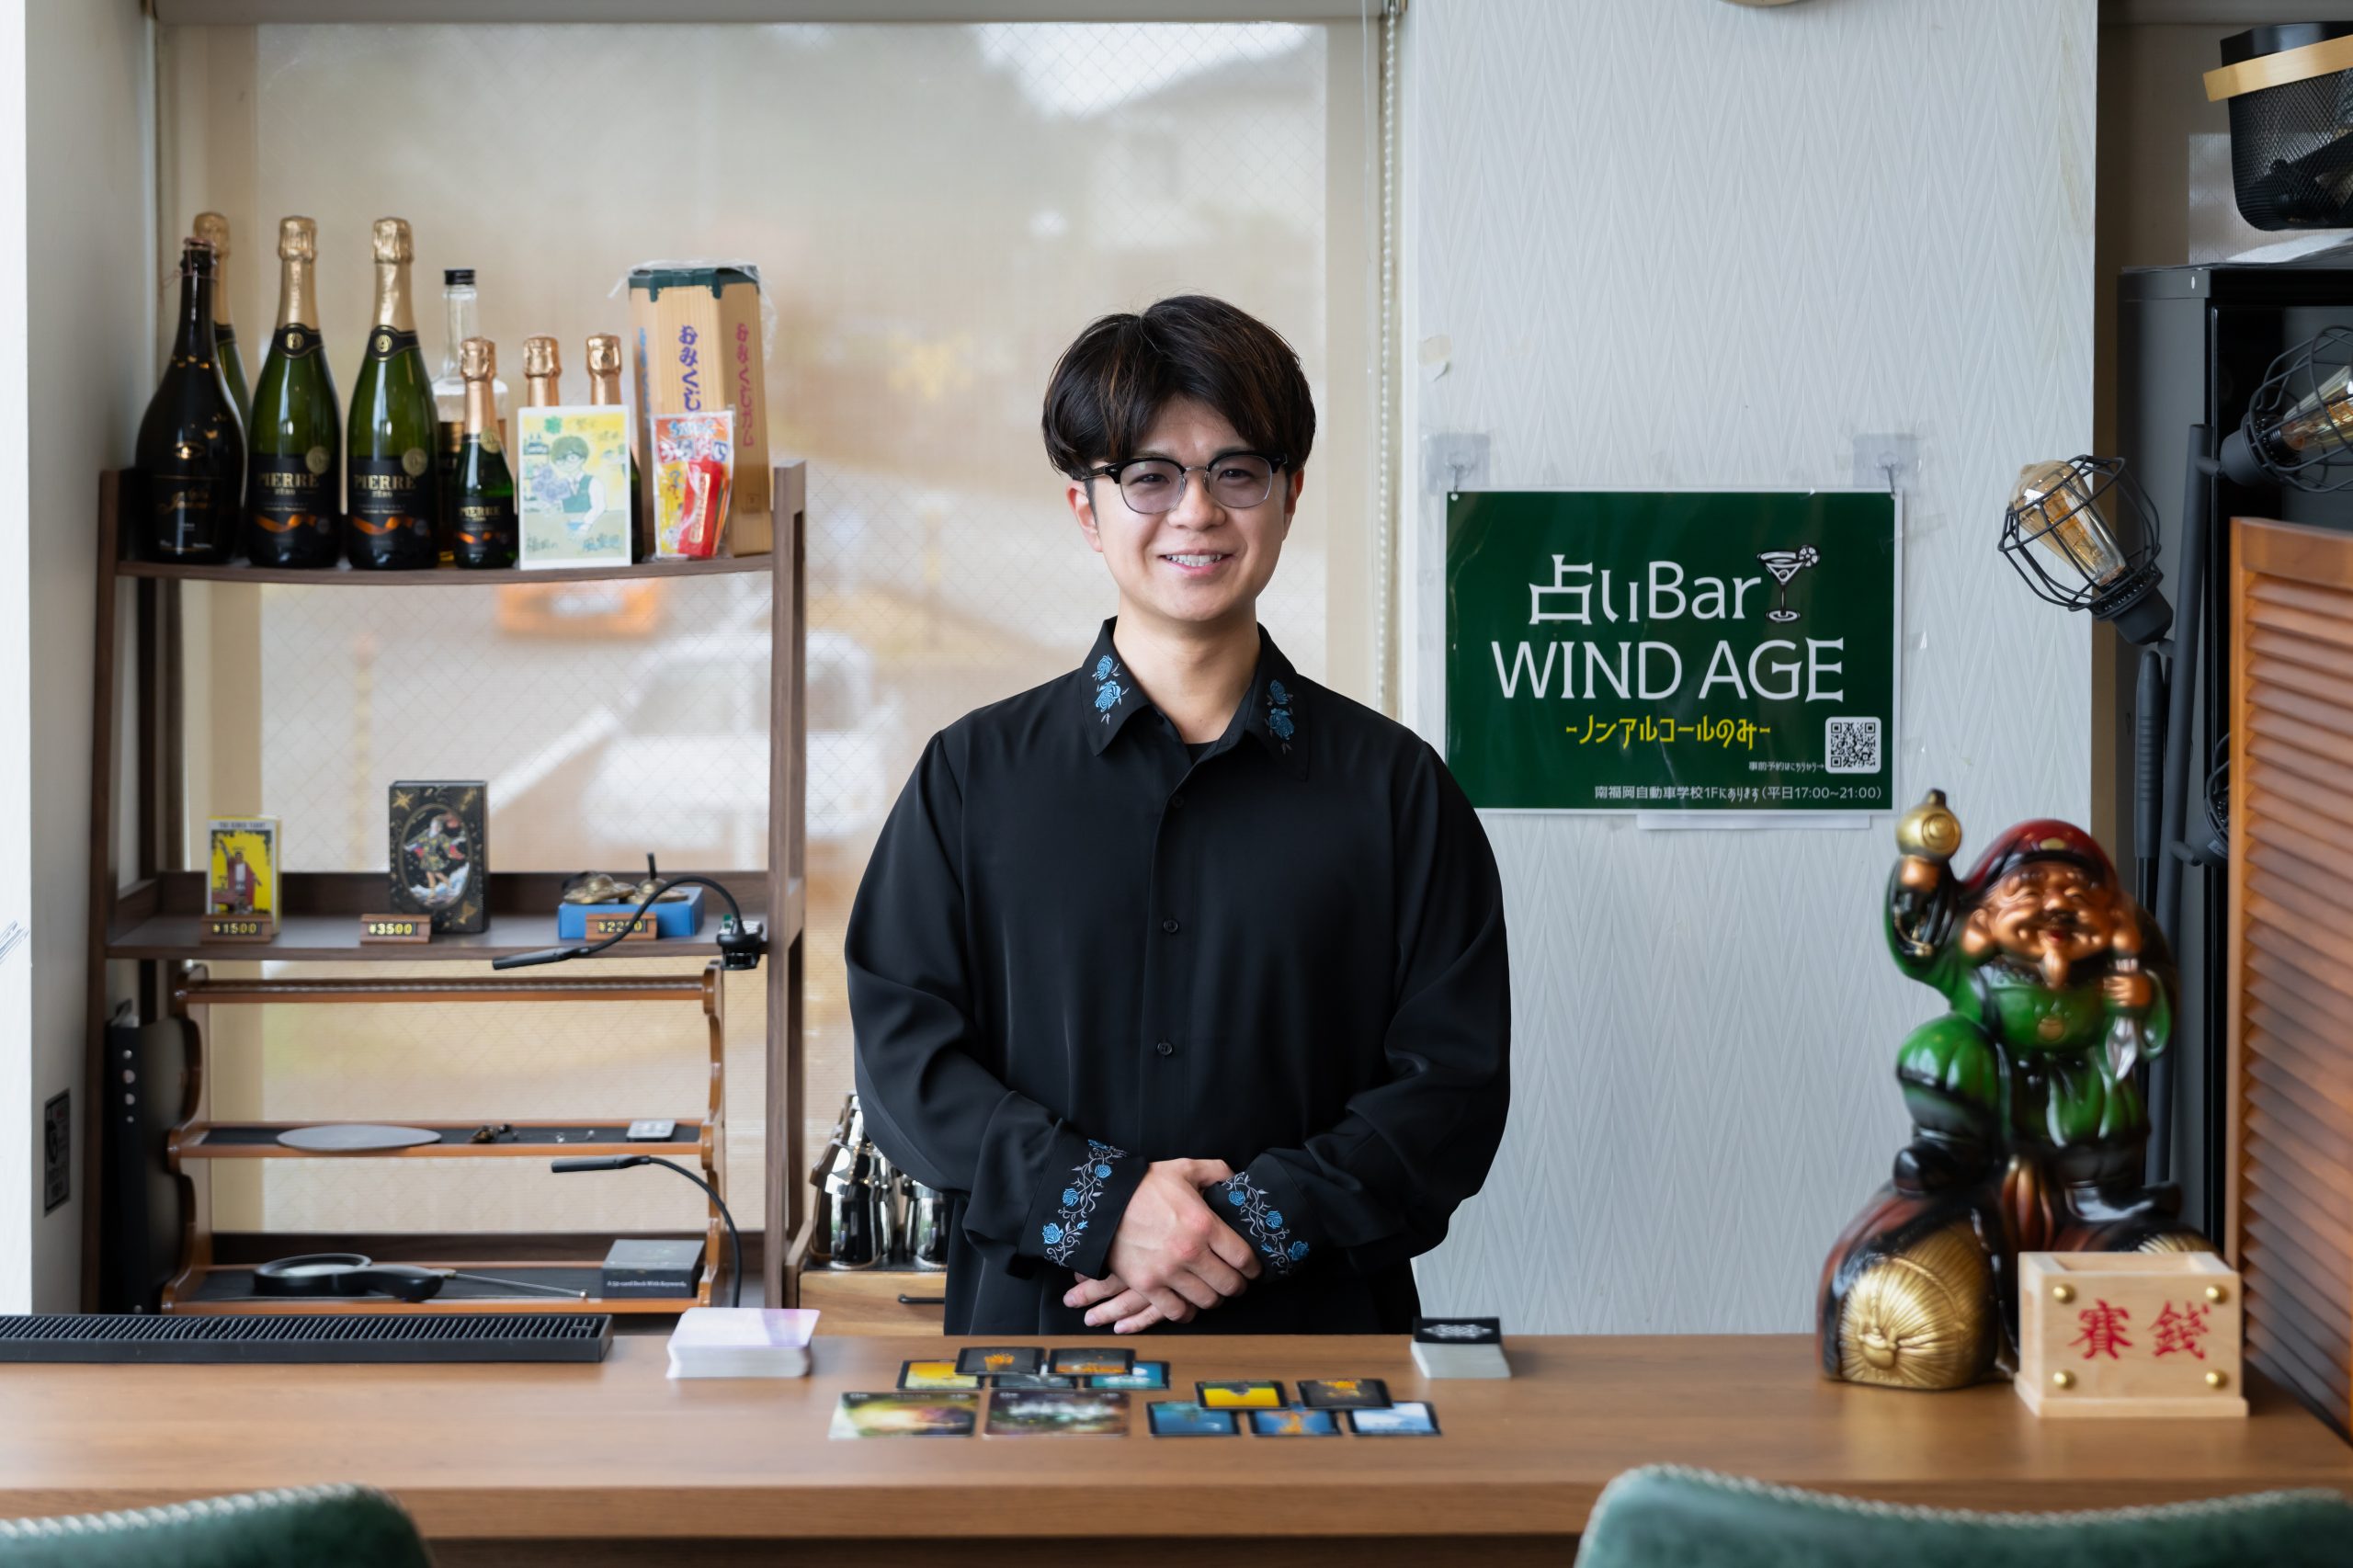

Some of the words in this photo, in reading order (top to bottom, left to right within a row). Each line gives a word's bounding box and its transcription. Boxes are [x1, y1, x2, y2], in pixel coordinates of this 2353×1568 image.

[678, 324, 701, 412] おみくじ
[353, 474, 416, 491] PIERRE
[1529, 553, 1761, 625] 占いBar
[1491, 640, 1683, 699] WIND
[1698, 636, 1845, 703] AGE
[369, 922, 413, 936] ¥3500
